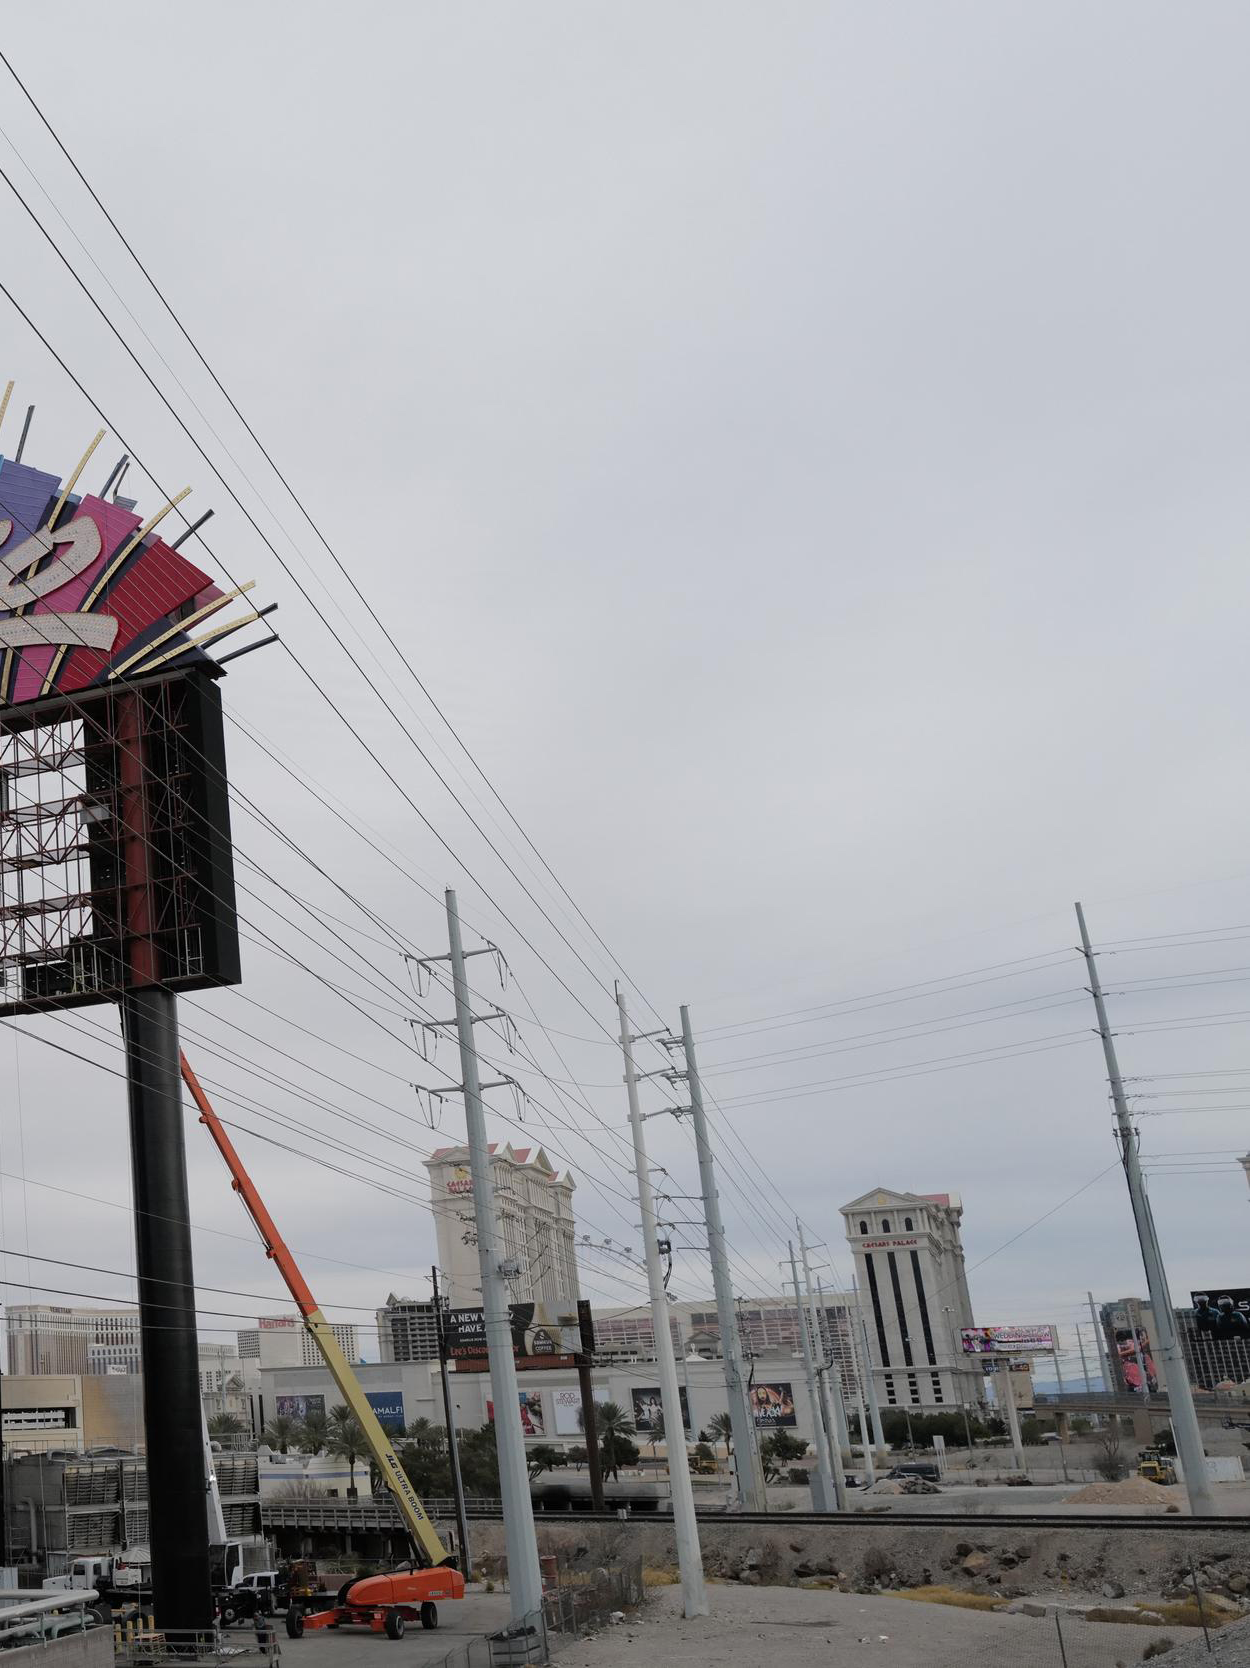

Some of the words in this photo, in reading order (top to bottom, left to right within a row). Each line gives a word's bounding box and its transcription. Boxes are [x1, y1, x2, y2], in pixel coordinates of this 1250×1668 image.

[450, 1315, 457, 1323] A
[458, 1313, 479, 1322] NEW
[459, 1324, 483, 1333] HAVE
[373, 1405, 403, 1415] AMALFI
[385, 1453, 398, 1469] JLG
[395, 1470, 411, 1496] ULTRA
[408, 1496, 424, 1520] BOOM
